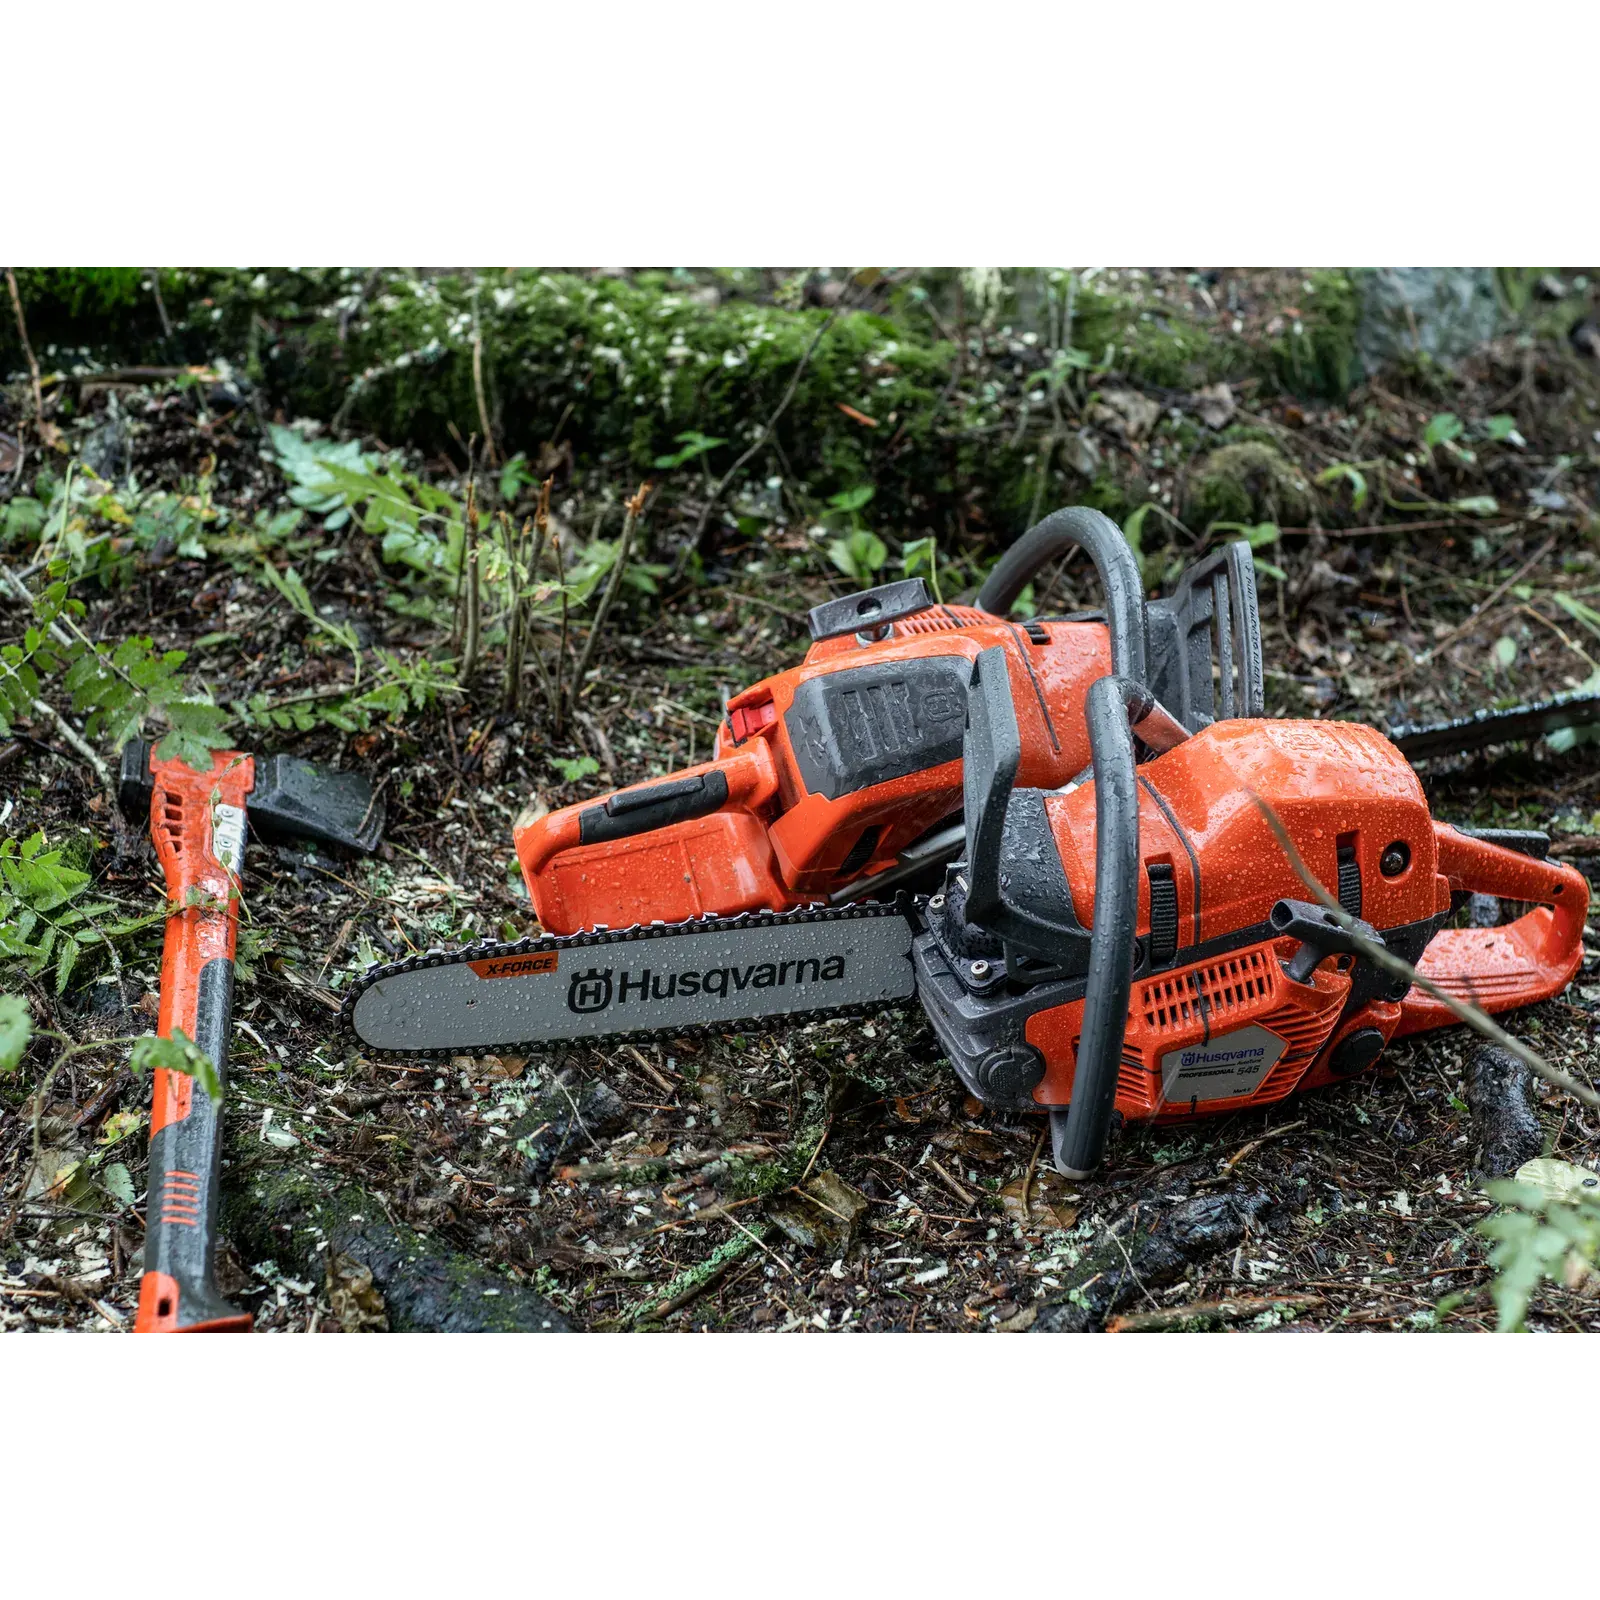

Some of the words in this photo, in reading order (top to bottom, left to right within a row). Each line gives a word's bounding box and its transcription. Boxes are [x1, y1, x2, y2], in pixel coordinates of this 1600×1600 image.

[486, 958, 554, 976] X-FORCE
[618, 953, 846, 1004] Husqvarna
[1196, 1047, 1264, 1062] Husqvarna
[1178, 1068, 1235, 1079] PROFESSIONAL
[1237, 1065, 1260, 1076] 545
